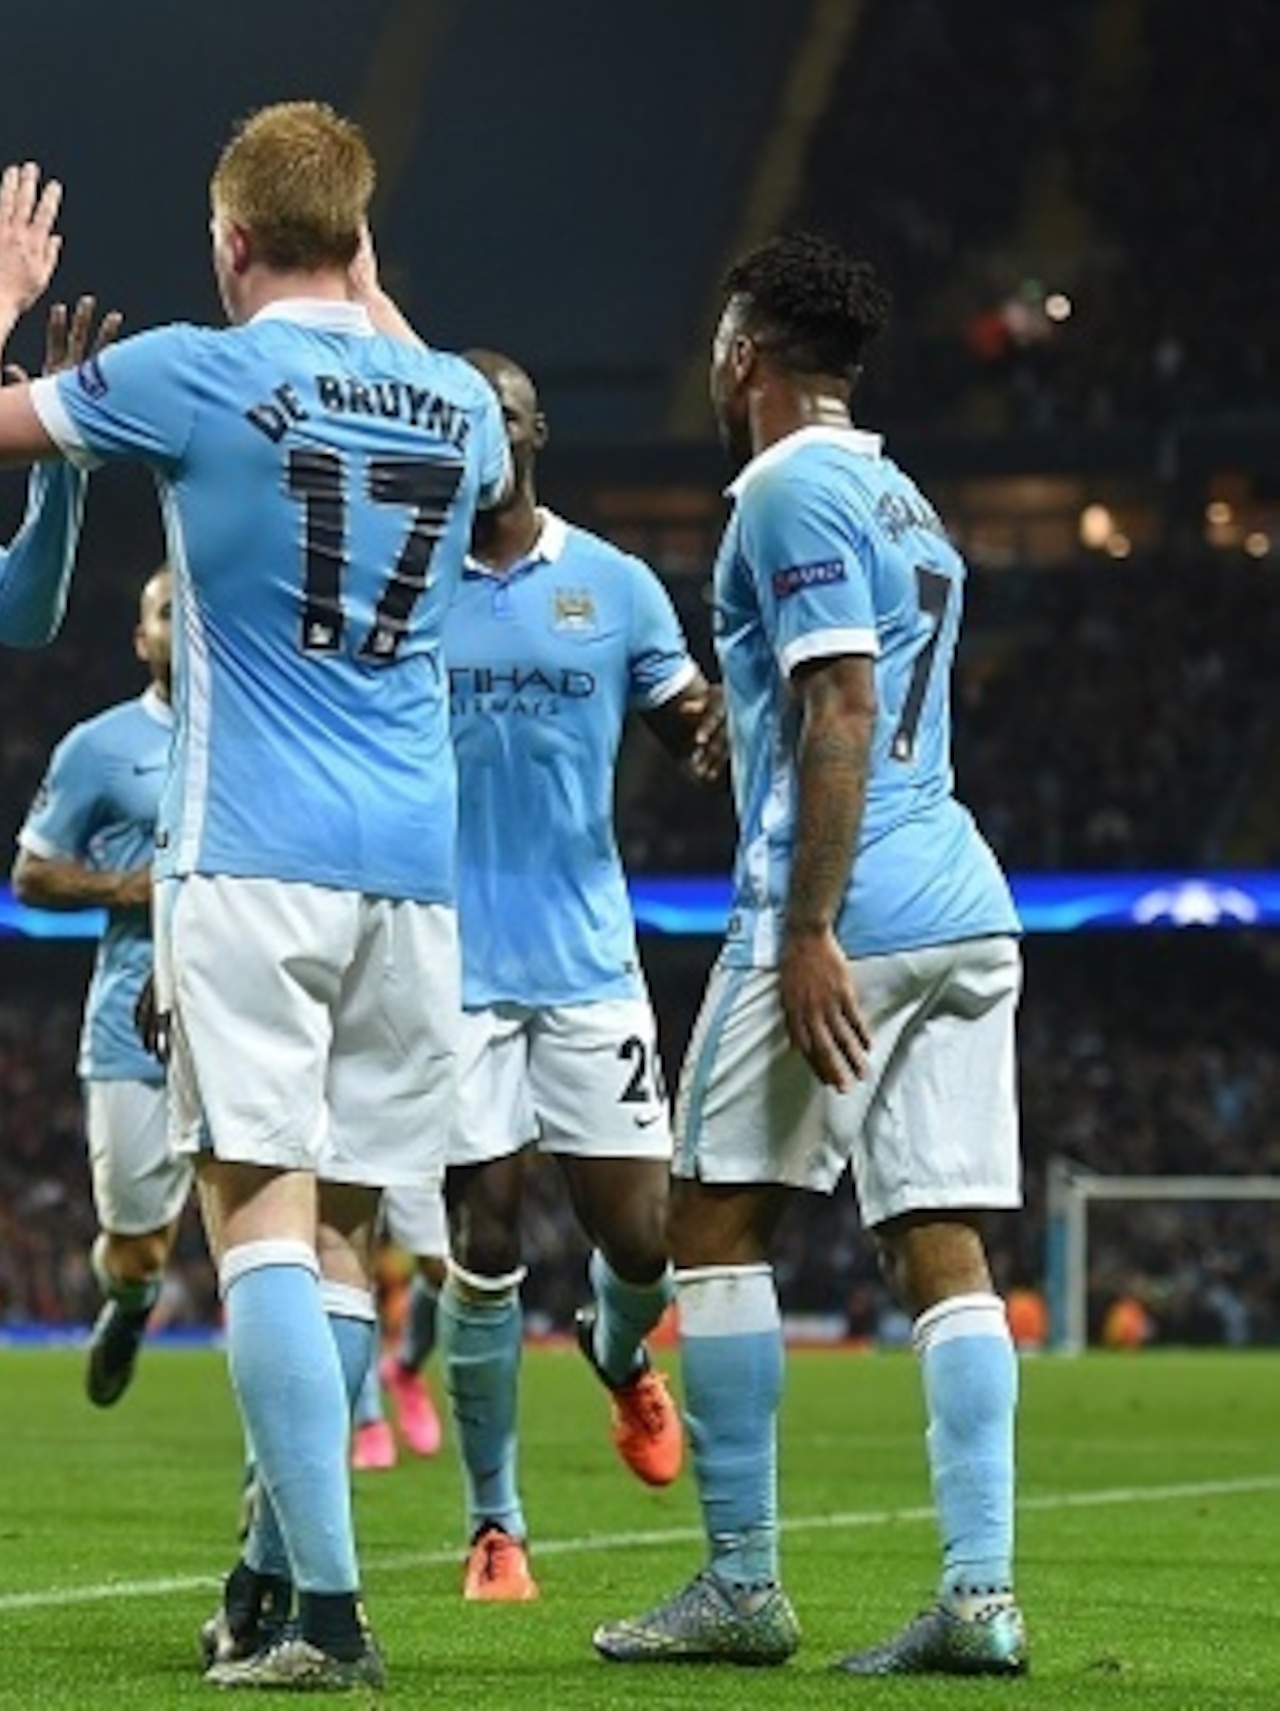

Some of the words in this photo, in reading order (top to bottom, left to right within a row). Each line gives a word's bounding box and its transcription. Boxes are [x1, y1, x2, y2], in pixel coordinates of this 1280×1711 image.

[245, 382, 310, 444] DE
[285, 448, 466, 663] 17
[448, 667, 596, 698] TIHAD
[890, 564, 954, 763] 7
[616, 1034, 668, 1106] 2
